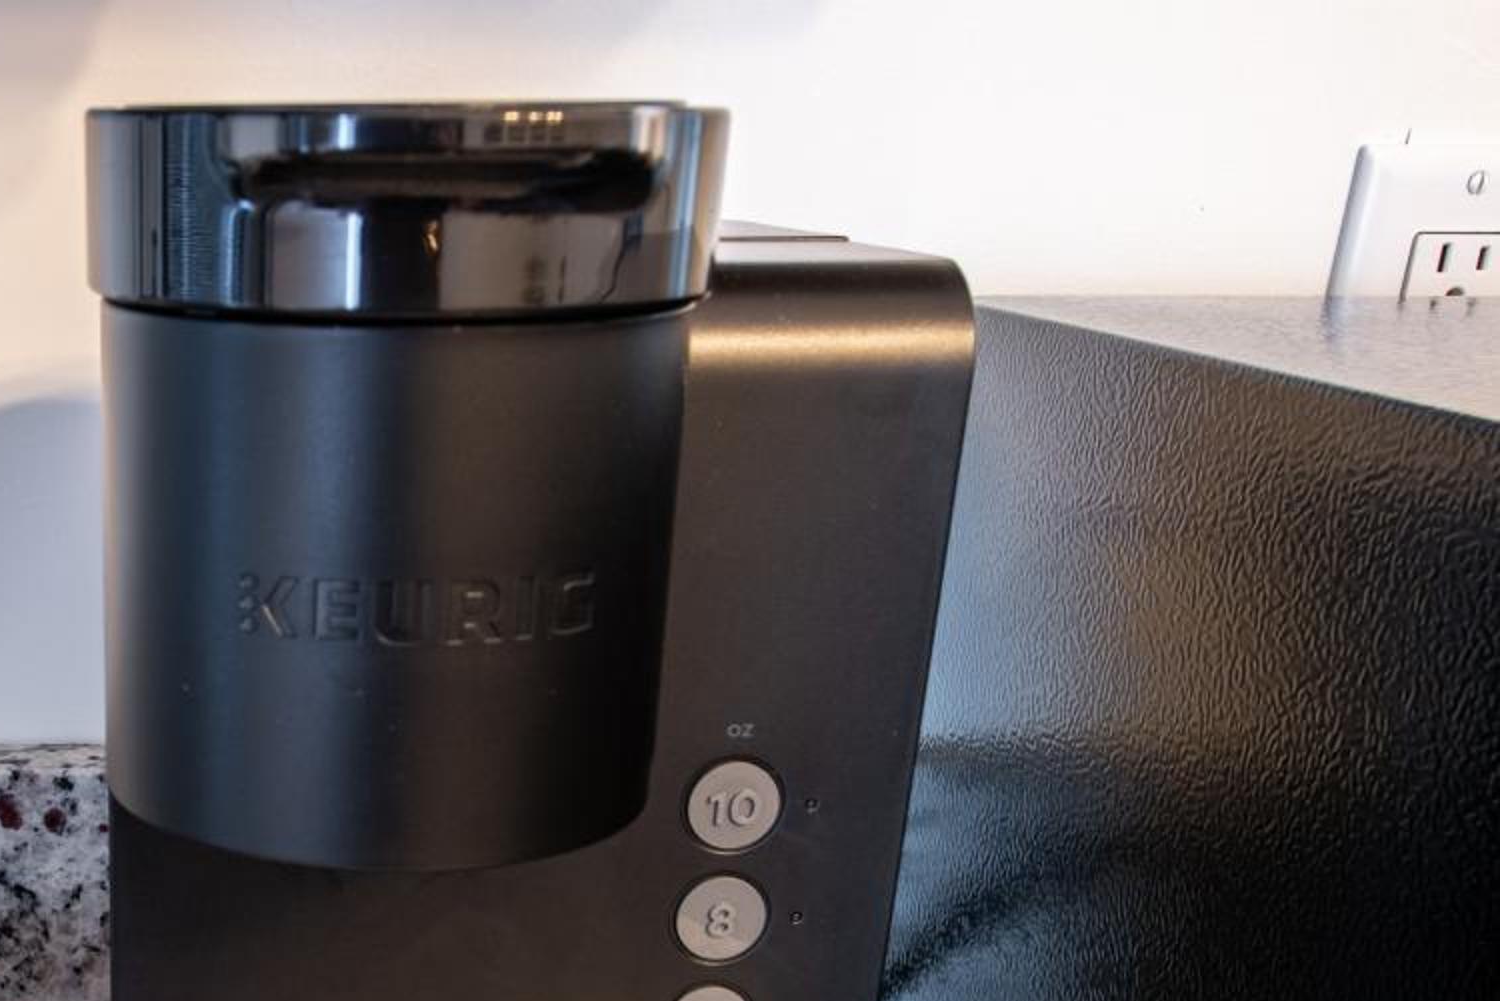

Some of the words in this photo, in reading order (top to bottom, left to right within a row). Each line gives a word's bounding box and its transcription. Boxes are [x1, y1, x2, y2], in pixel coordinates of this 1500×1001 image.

[235, 572, 596, 646] KEURIG
[726, 723, 756, 738] OZ
[705, 789, 758, 828] 10
[704, 902, 736, 939] 8
